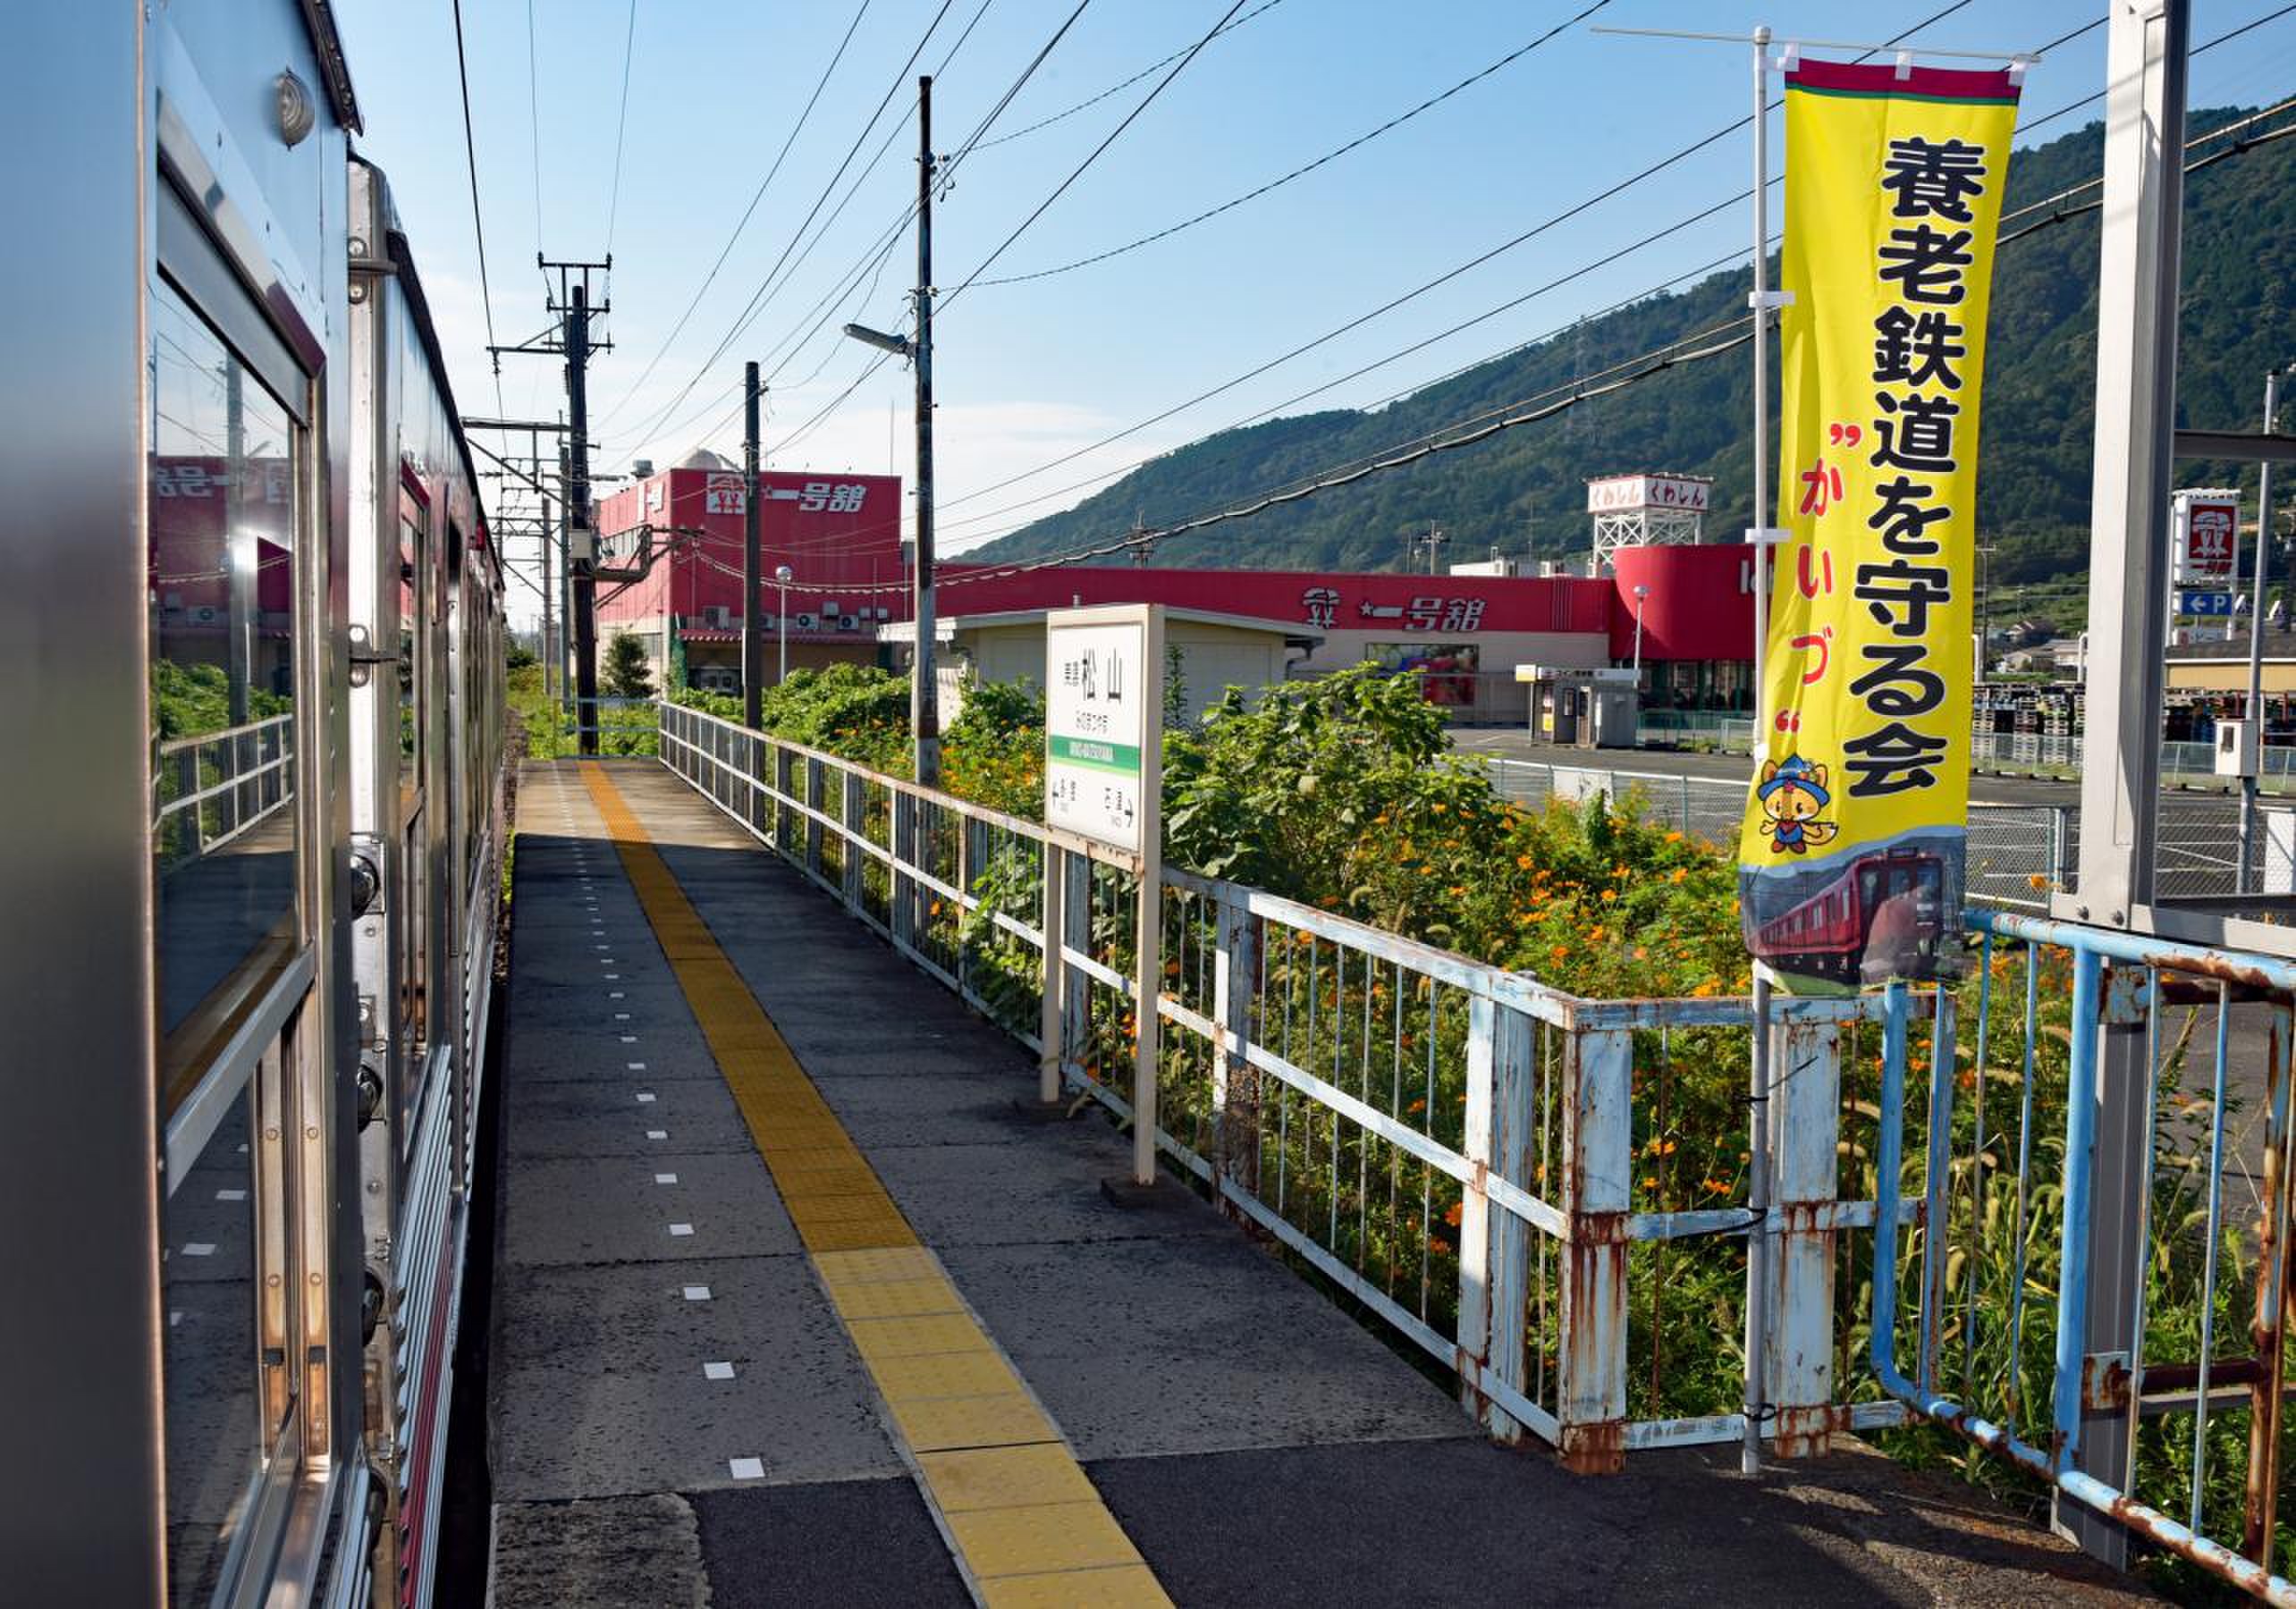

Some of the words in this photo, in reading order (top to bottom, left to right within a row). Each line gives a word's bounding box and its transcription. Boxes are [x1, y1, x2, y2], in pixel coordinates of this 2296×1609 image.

[1844, 136, 1986, 799] 養老鉄道を守る会
[1650, 480, 1705, 508] くわしん
[2213, 594, 2227, 614] P
